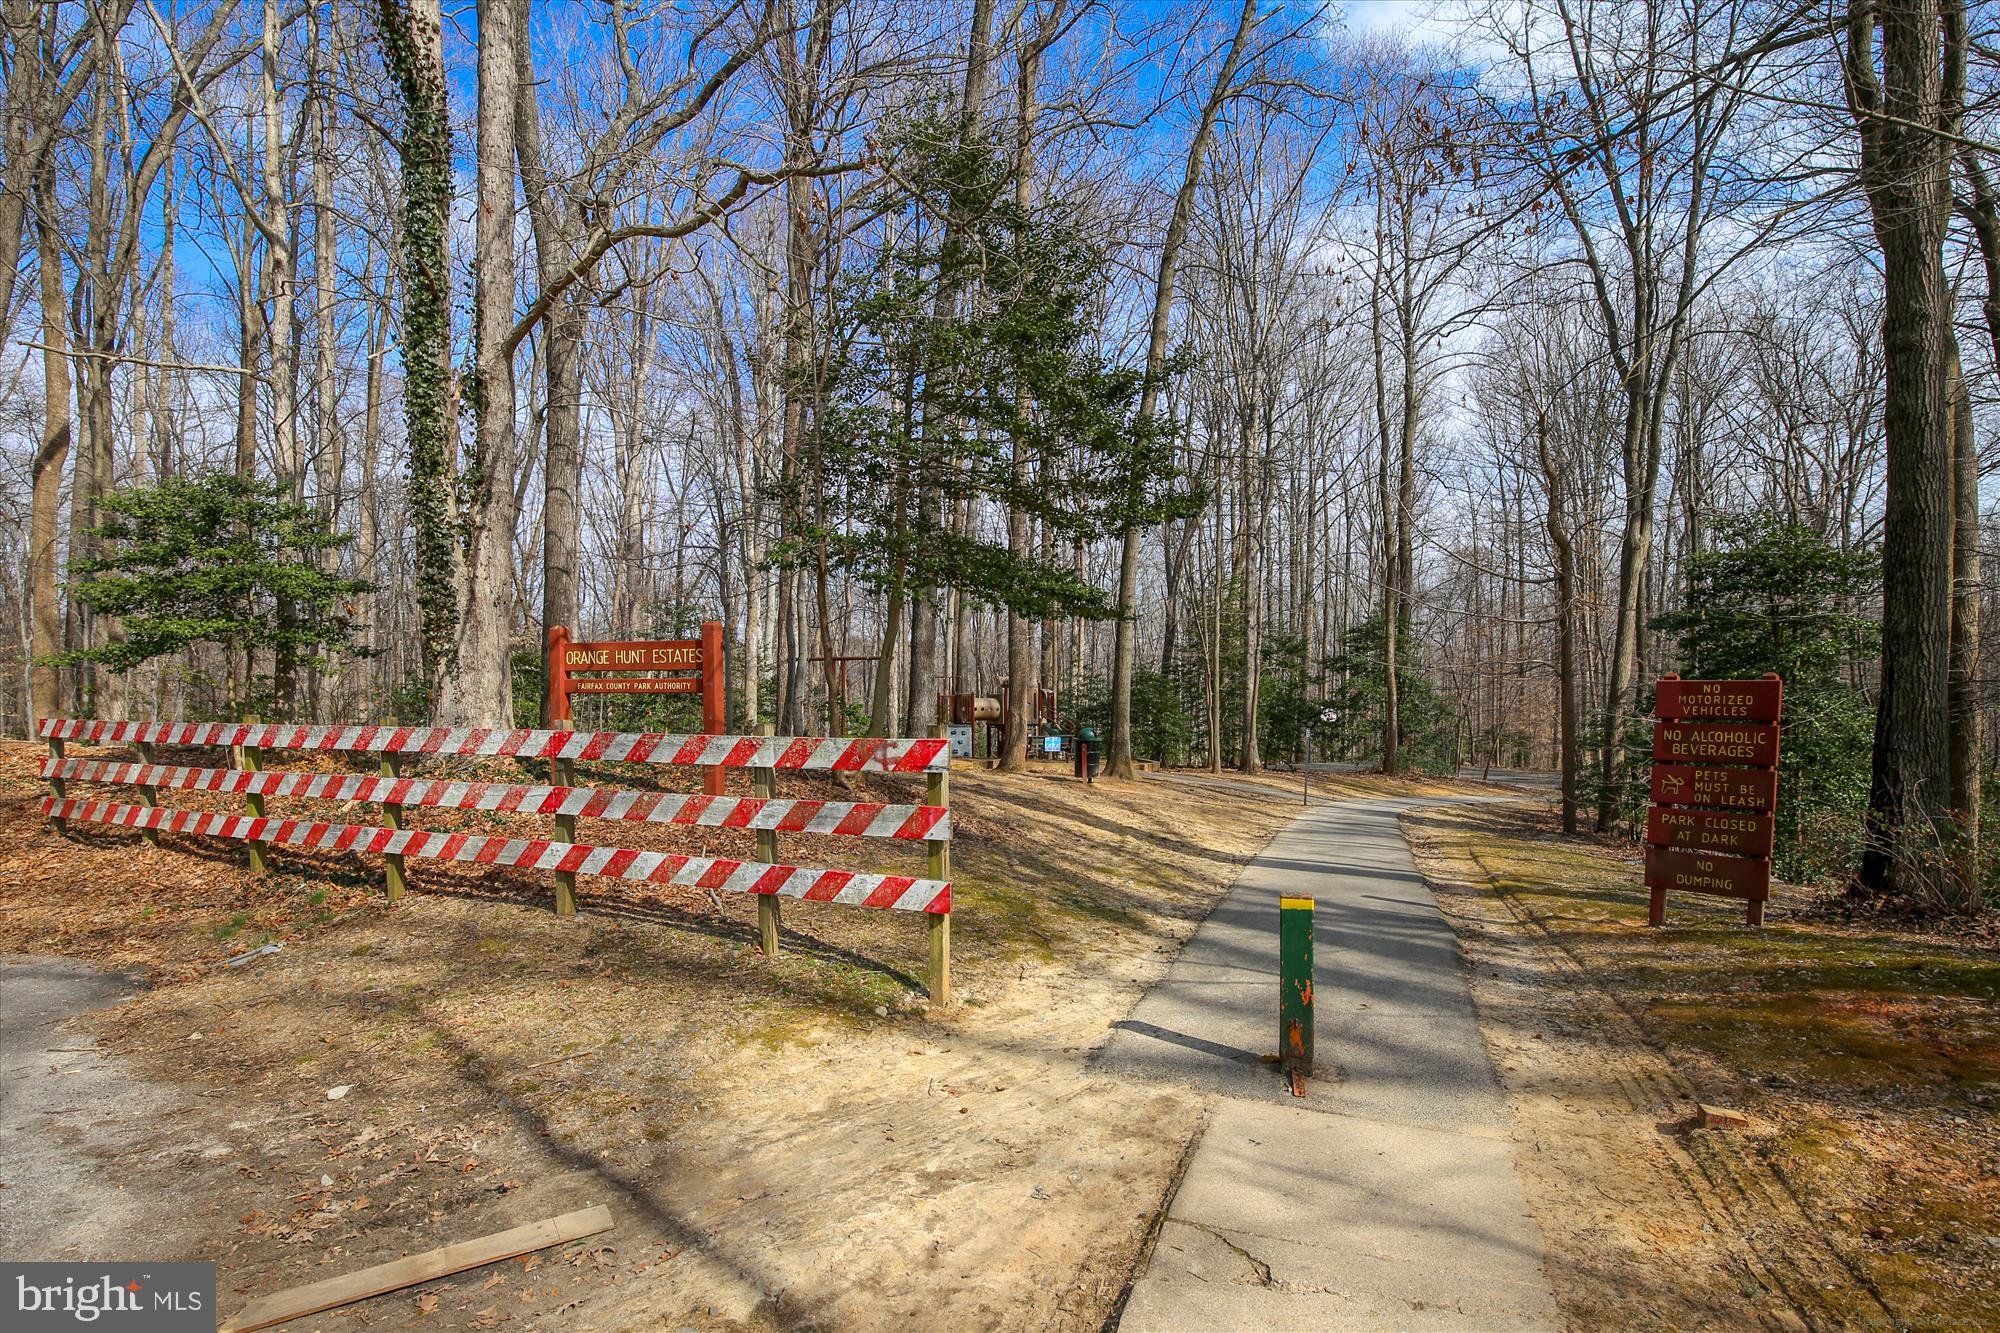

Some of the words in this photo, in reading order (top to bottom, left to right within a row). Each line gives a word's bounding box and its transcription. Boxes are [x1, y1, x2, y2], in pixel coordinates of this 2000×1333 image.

[566, 650, 610, 665] ORANGE
[615, 649, 647, 664] HUNT
[652, 648, 703, 664] ESTATES
[577, 682, 603, 690] FAIRFAX
[606, 682, 631, 690] COUNTY
[633, 682, 651, 690] PARK
[654, 681, 692, 690] AUTHORITY
[1703, 684, 1721, 694] NO
[1678, 695, 1754, 705] MOTORIZED
[1682, 706, 1748, 716] VEHICLES
[1663, 730, 1682, 741] NO
[1690, 730, 1767, 745] ALCOHOLIC
[1672, 743, 1756, 758] BEVERAGES
[1695, 770, 1728, 782] PETS
[1694, 782, 1730, 793] MUST
[1740, 785, 1756, 795] BE
[1694, 793, 1711, 803] ON
[1721, 795, 1766, 808] LEASH
[1661, 813, 1696, 827] PARK
[1705, 817, 1757, 832] CLOSED
[1676, 831, 1692, 841] AT
[1701, 832, 1739, 846] DARK
[1696, 860, 1714, 872] NO
[1676, 873, 1734, 890] DUMPING
